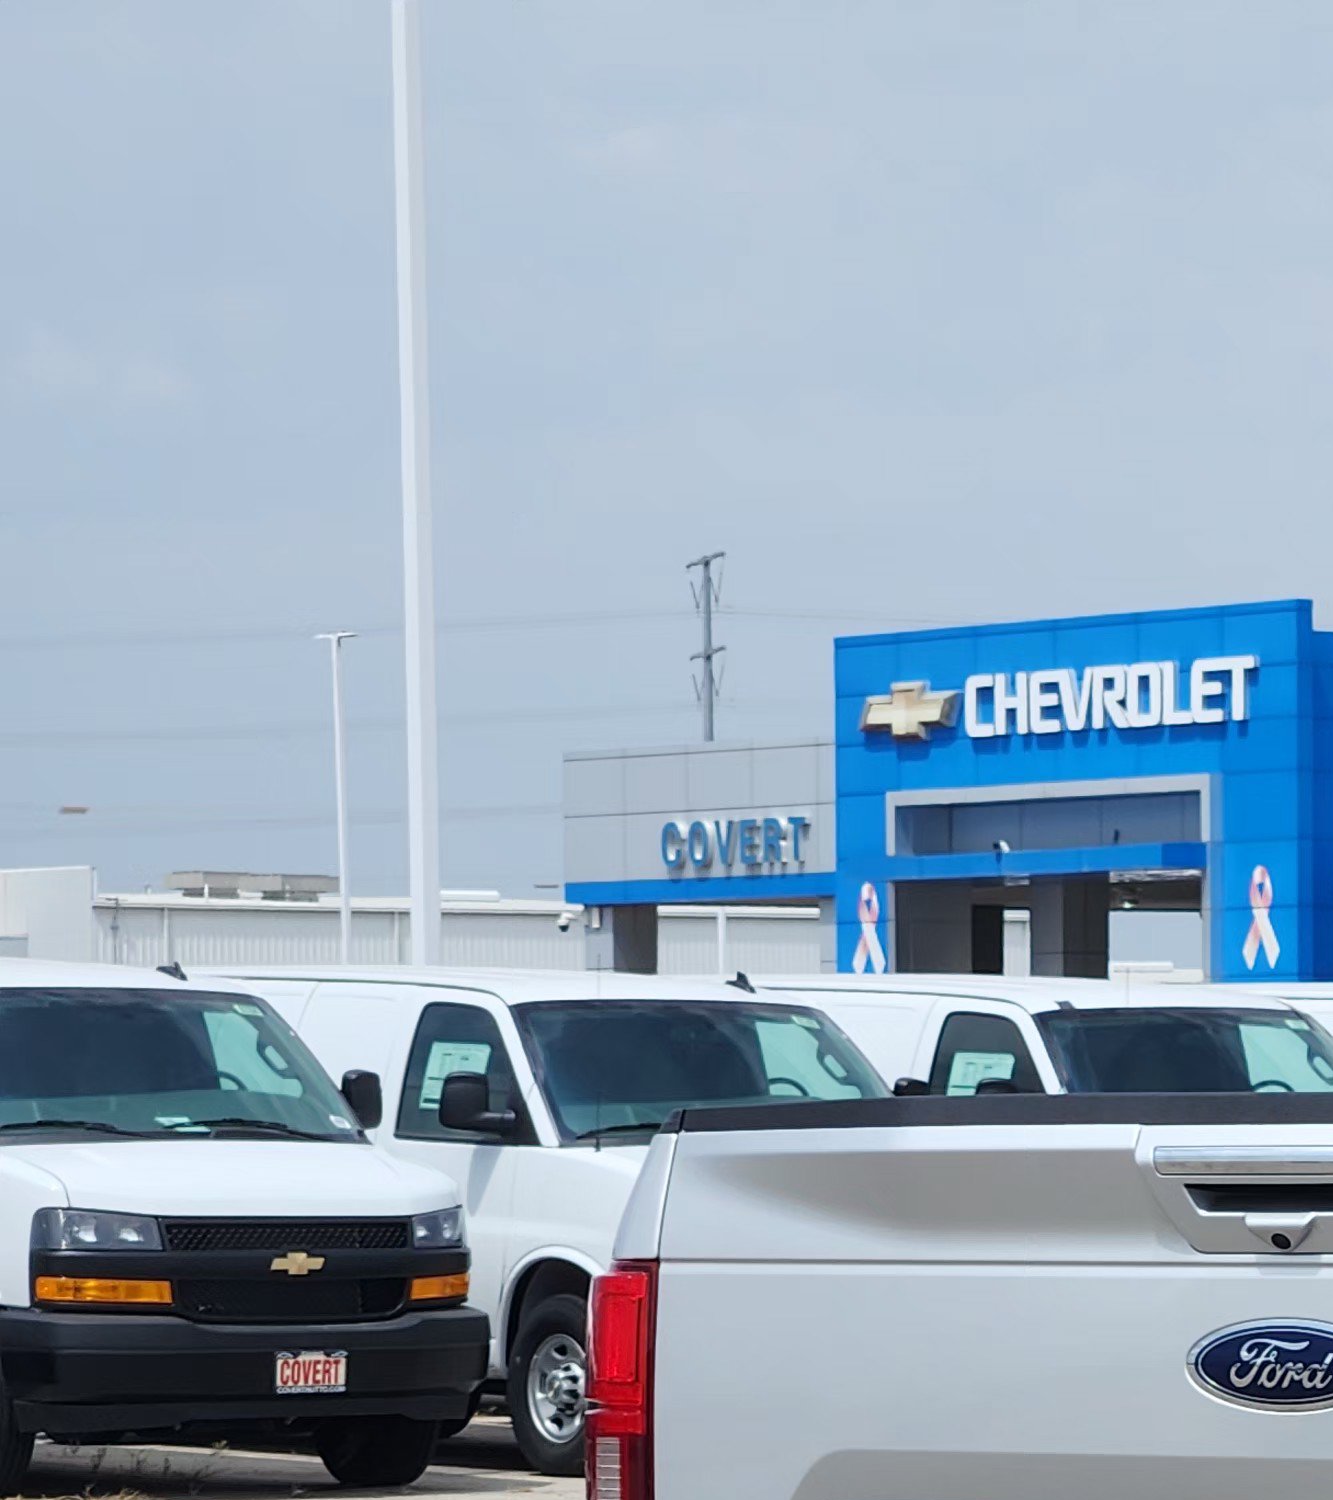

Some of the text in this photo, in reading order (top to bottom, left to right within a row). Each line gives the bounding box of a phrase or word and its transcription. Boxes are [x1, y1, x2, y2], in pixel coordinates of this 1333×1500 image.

[964, 655, 1256, 738] CHEVROLET
[661, 816, 806, 868] COVERT
[280, 1359, 341, 1386] COVERT
